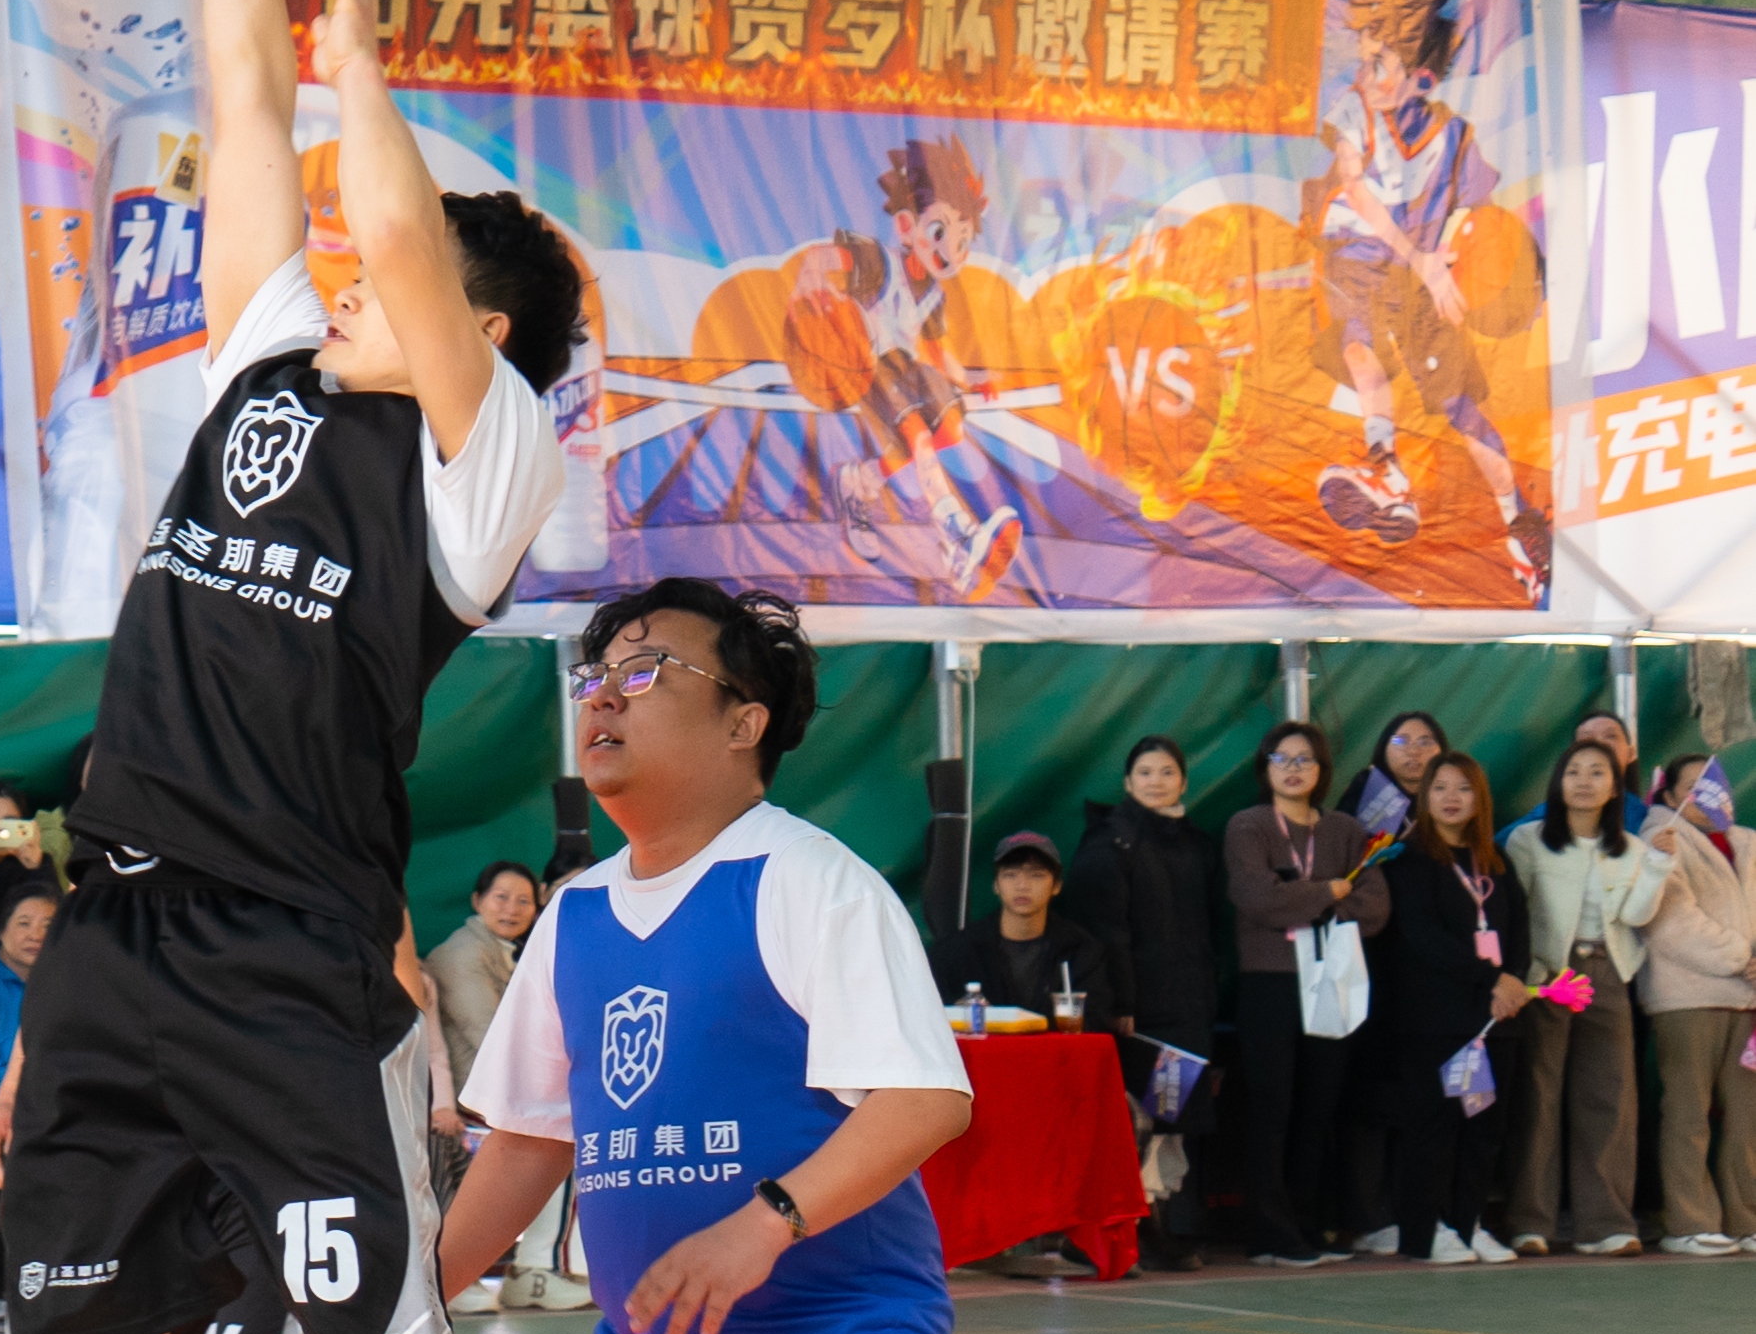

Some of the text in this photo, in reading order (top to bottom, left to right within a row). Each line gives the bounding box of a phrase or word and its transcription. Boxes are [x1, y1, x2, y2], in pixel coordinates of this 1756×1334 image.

[1526, 78, 1756, 379] 水
[1105, 345, 1196, 418] VS
[236, 583, 333, 623] GROUP
[576, 1120, 741, 1166] 圣斯集团
[577, 1162, 742, 1194] GSONS GROUP
[276, 1196, 361, 1304] 15
